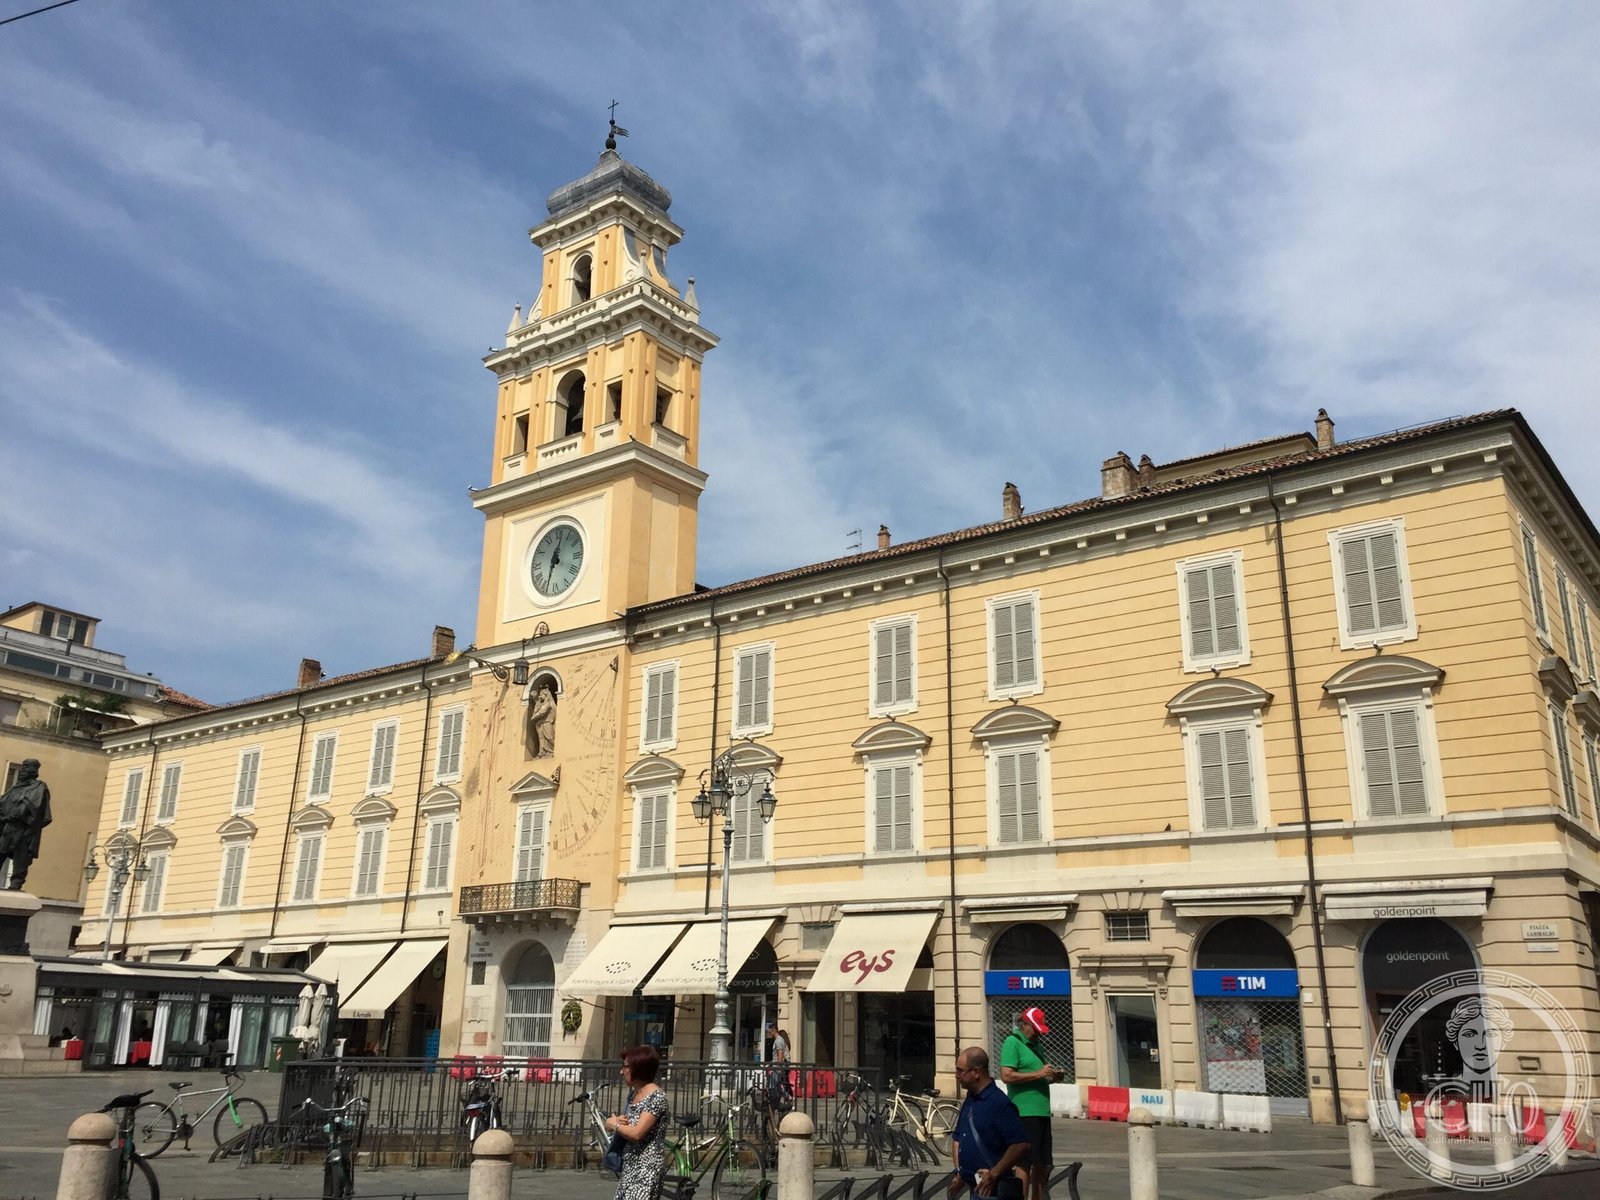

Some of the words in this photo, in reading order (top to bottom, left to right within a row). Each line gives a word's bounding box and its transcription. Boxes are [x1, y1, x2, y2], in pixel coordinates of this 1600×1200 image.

[1373, 906, 1437, 918] goldenpoint
[1386, 951, 1450, 963] goldenpoint
[840, 949, 896, 986] eys
[1021, 976, 1045, 989] TIM
[1237, 976, 1266, 990] TIM
[1141, 1094, 1163, 1105] NAU
